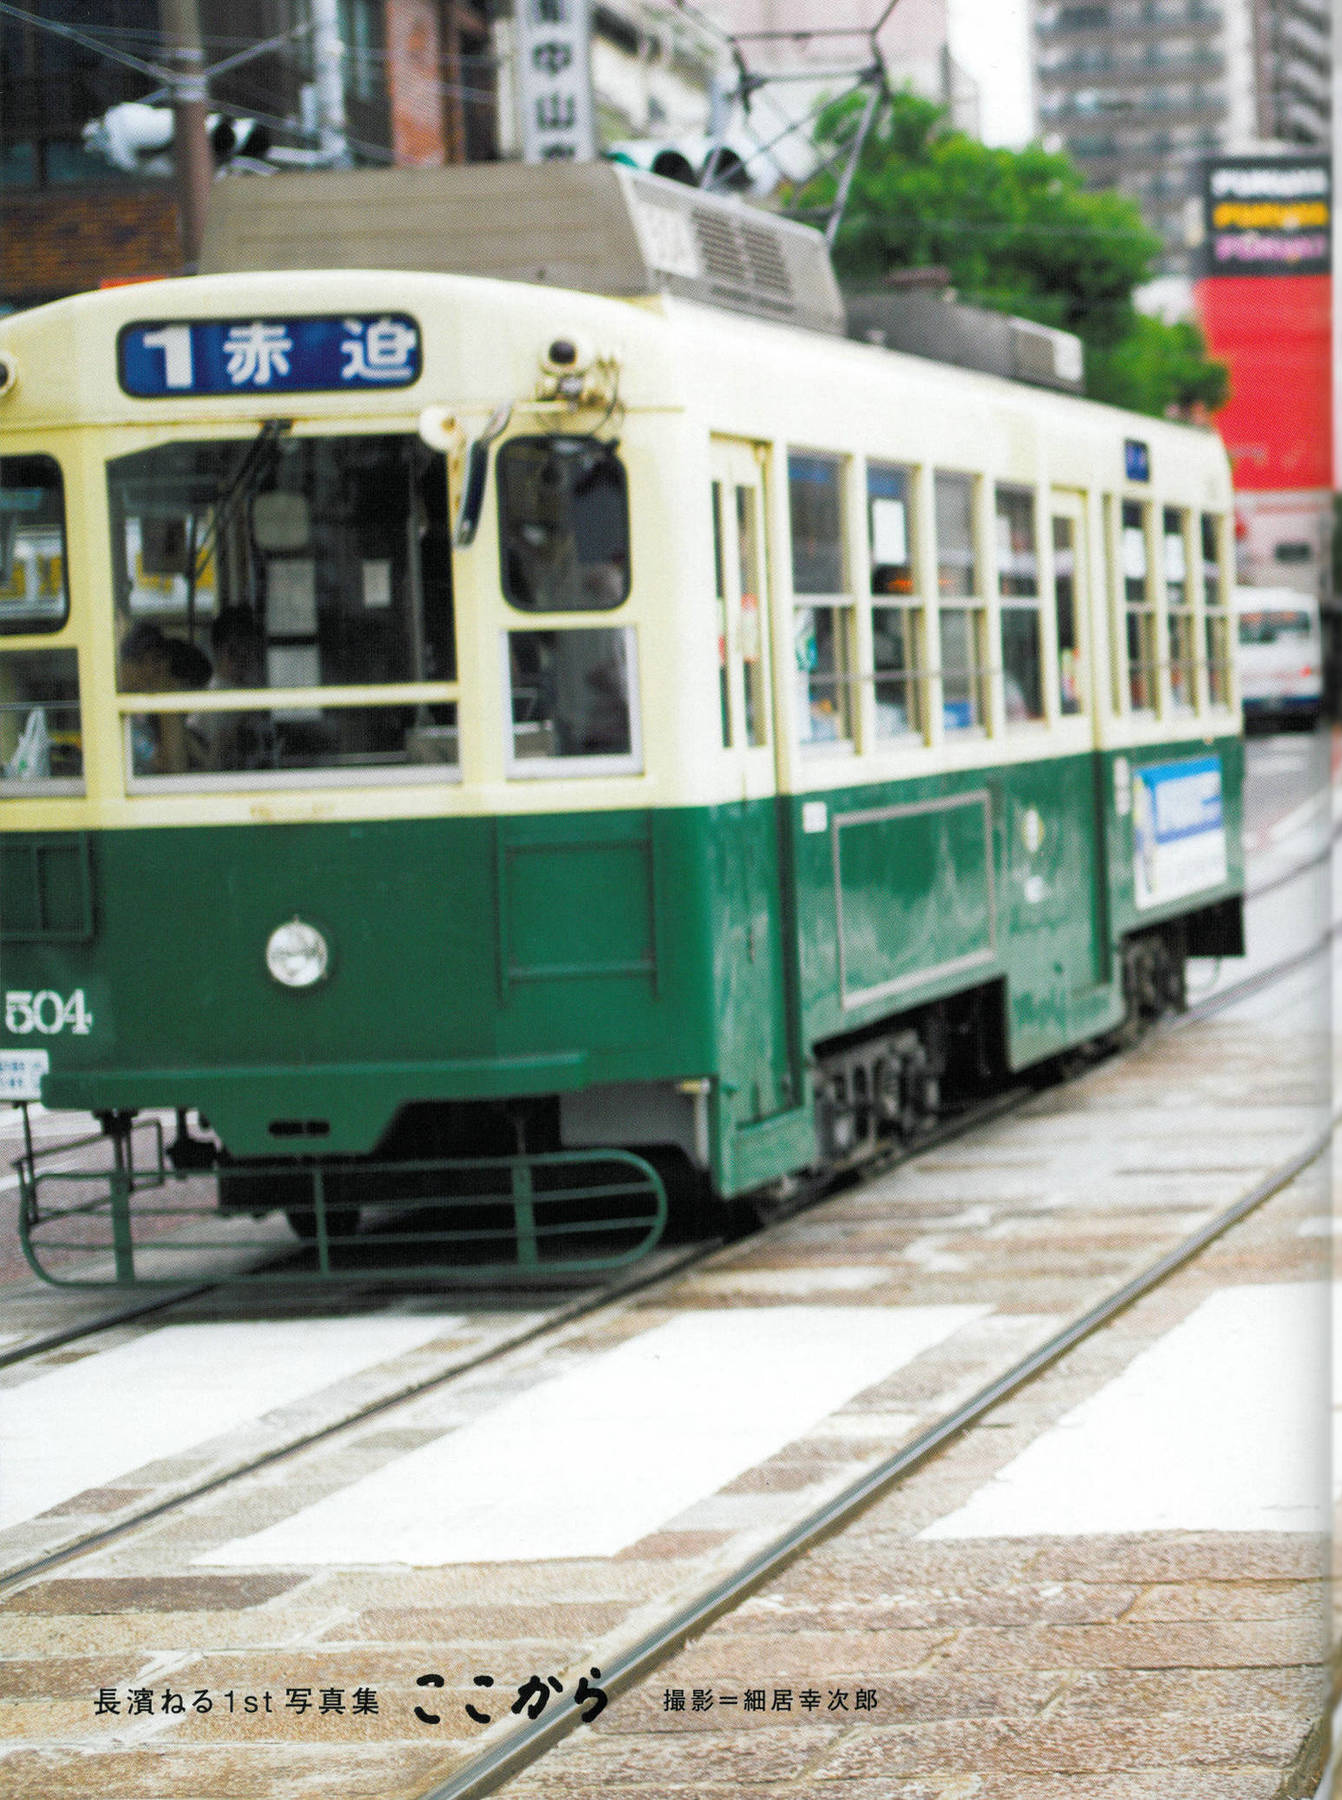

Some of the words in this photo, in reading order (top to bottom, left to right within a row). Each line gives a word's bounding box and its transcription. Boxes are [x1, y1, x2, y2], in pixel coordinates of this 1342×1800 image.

[143, 325, 192, 388] 1
[222, 319, 417, 385] 赤迫
[5, 988, 93, 1035] 504
